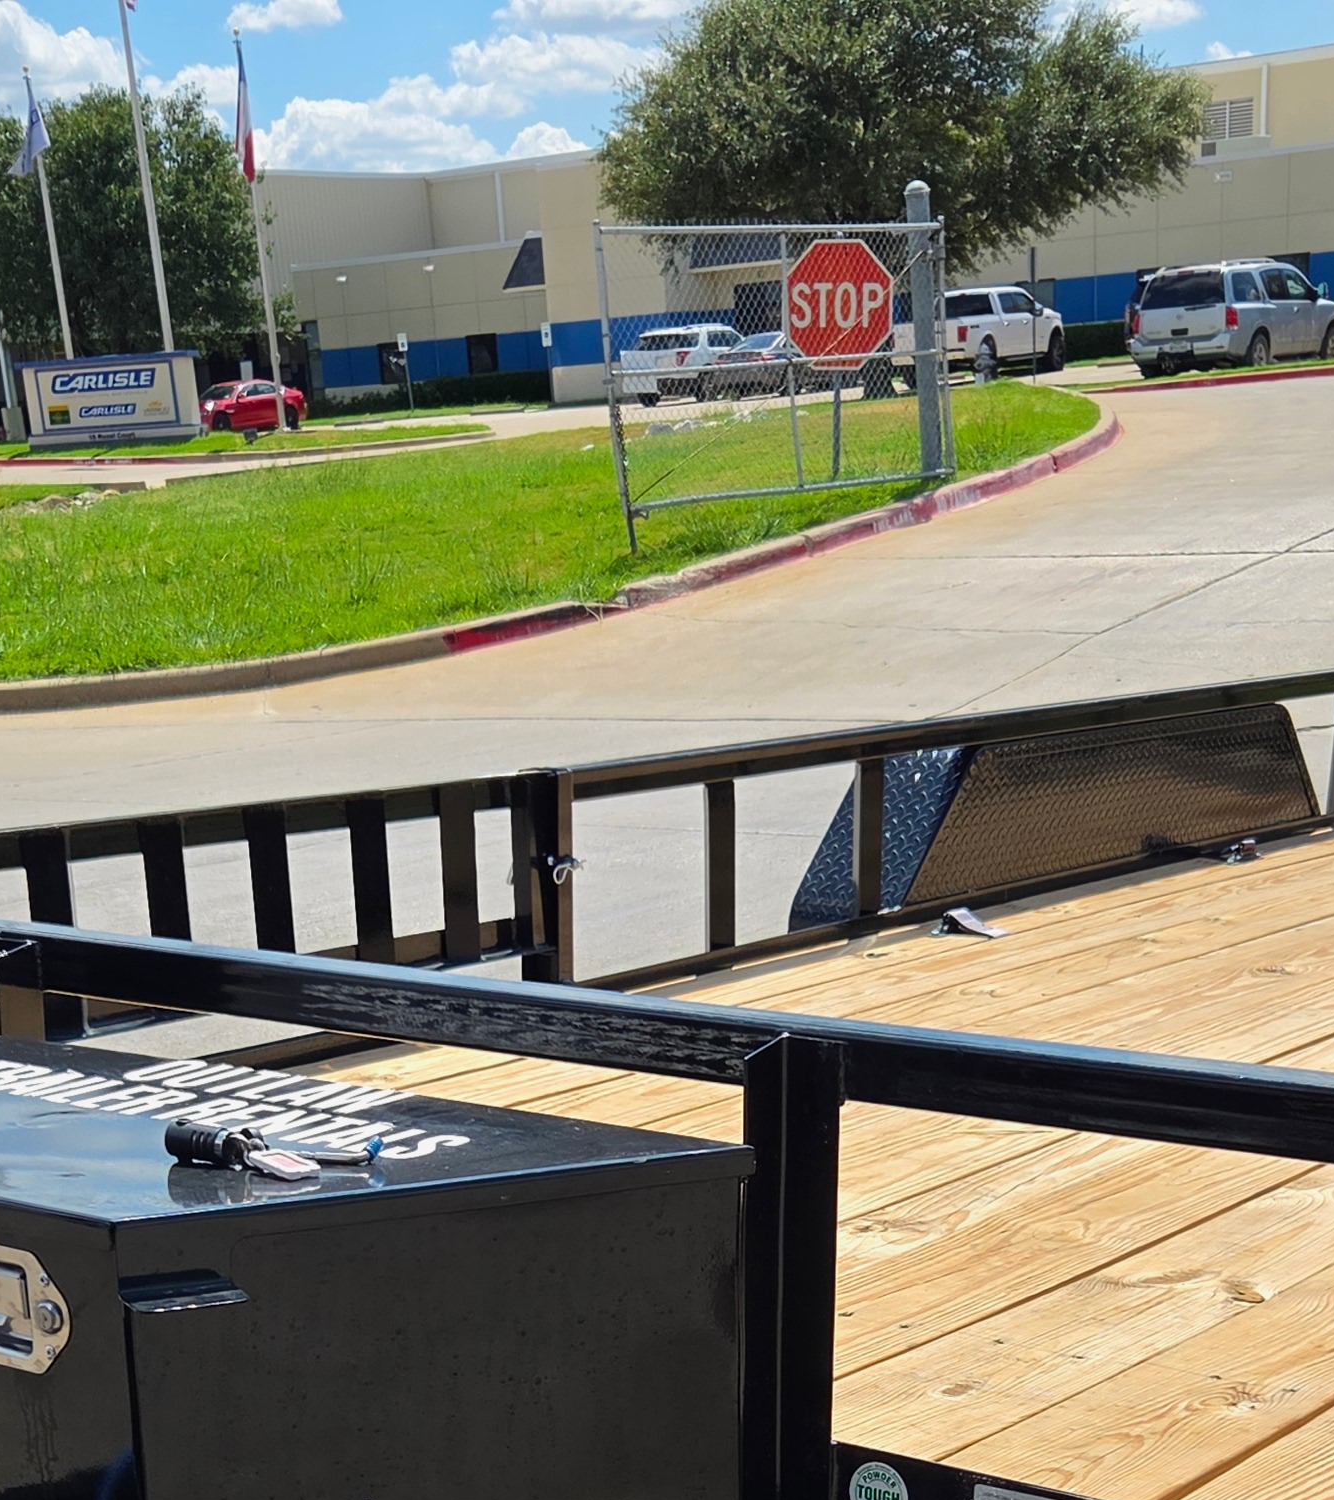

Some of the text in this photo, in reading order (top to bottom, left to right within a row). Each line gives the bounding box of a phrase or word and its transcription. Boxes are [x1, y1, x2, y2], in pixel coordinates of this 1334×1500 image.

[790, 281, 886, 329] STOP
[54, 370, 153, 391] CARLISLE
[80, 404, 135, 417] CARLISLE
[123, 1059, 415, 1114] OUTLAW
[151, 1097, 471, 1160] RENTALS
[862, 1471, 897, 1488] POWDER
